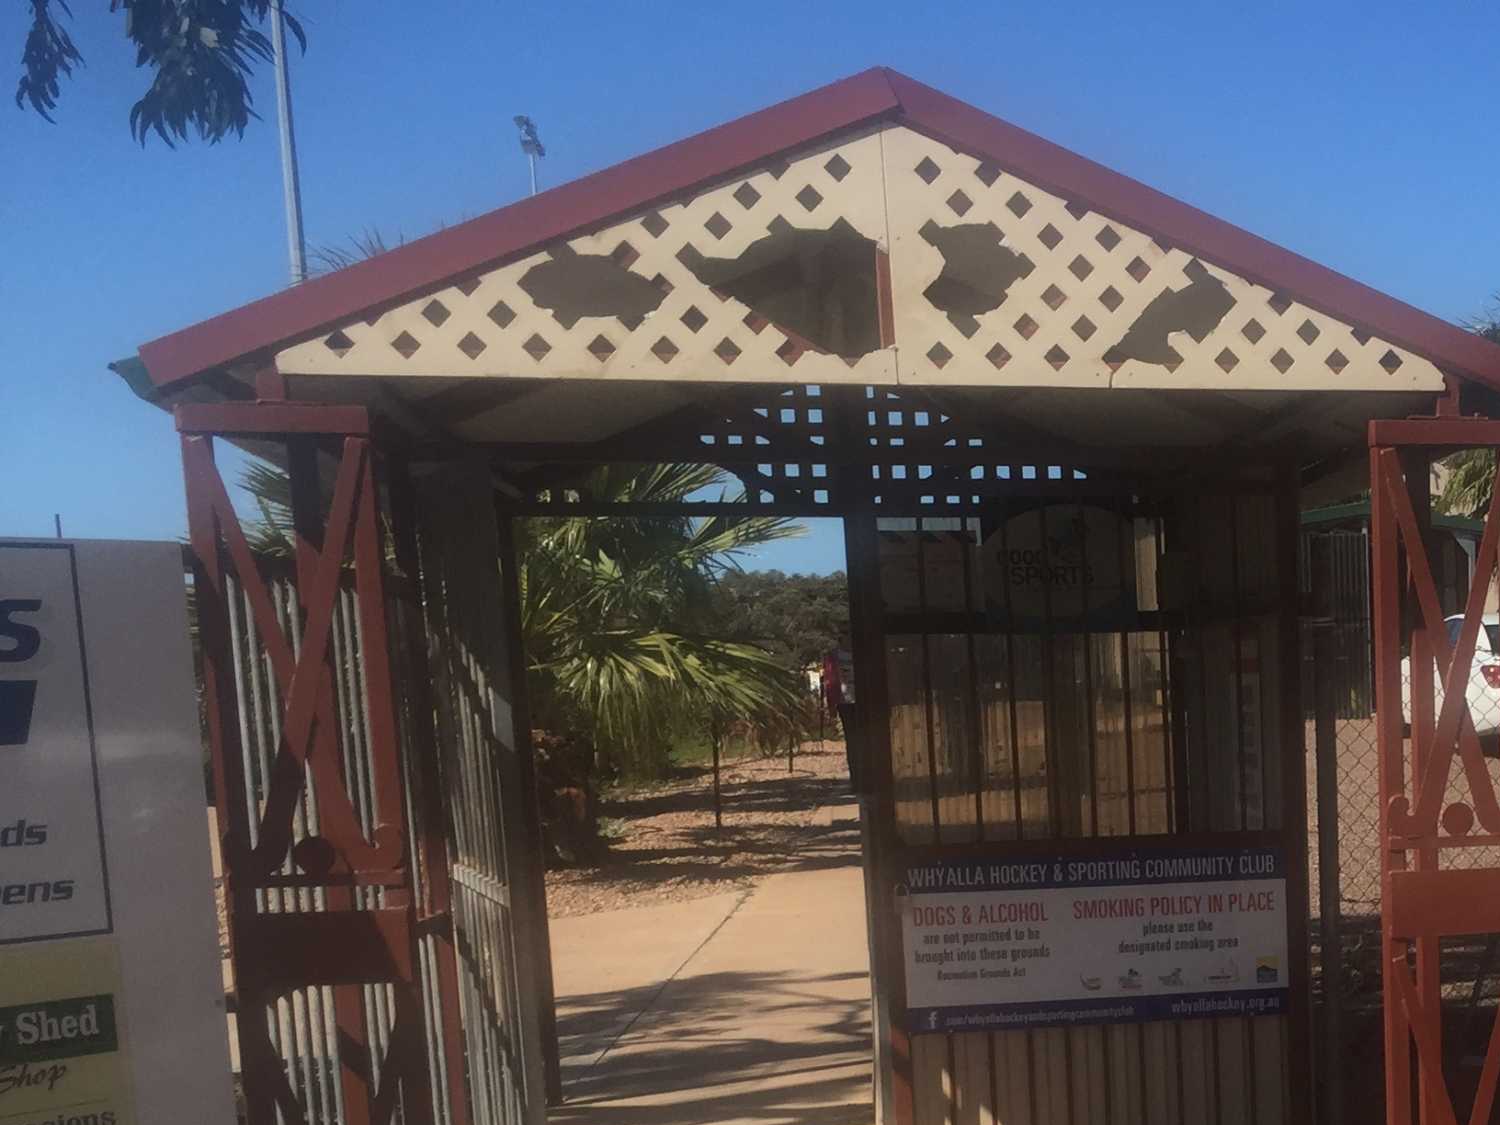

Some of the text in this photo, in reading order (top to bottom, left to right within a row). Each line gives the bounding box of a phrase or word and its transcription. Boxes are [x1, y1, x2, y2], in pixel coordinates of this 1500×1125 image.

[907, 854, 1275, 888] WHYALLA HOCKEY & SPORTING COMMUNITY CLUB
[913, 902, 1049, 927] DOGS & ALCOHOL
[1073, 891, 1275, 920] SMOKING POLICY IN PLACE
[923, 933, 940, 945] are
[943, 931, 960, 944] not
[962, 928, 1012, 945] permitted
[1015, 928, 1025, 941] to
[1142, 918, 1213, 936] please use the
[914, 944, 1051, 965] brought into these grounds
[1118, 935, 1238, 955] designated smoking area
[15, 1003, 99, 1045] Shed
